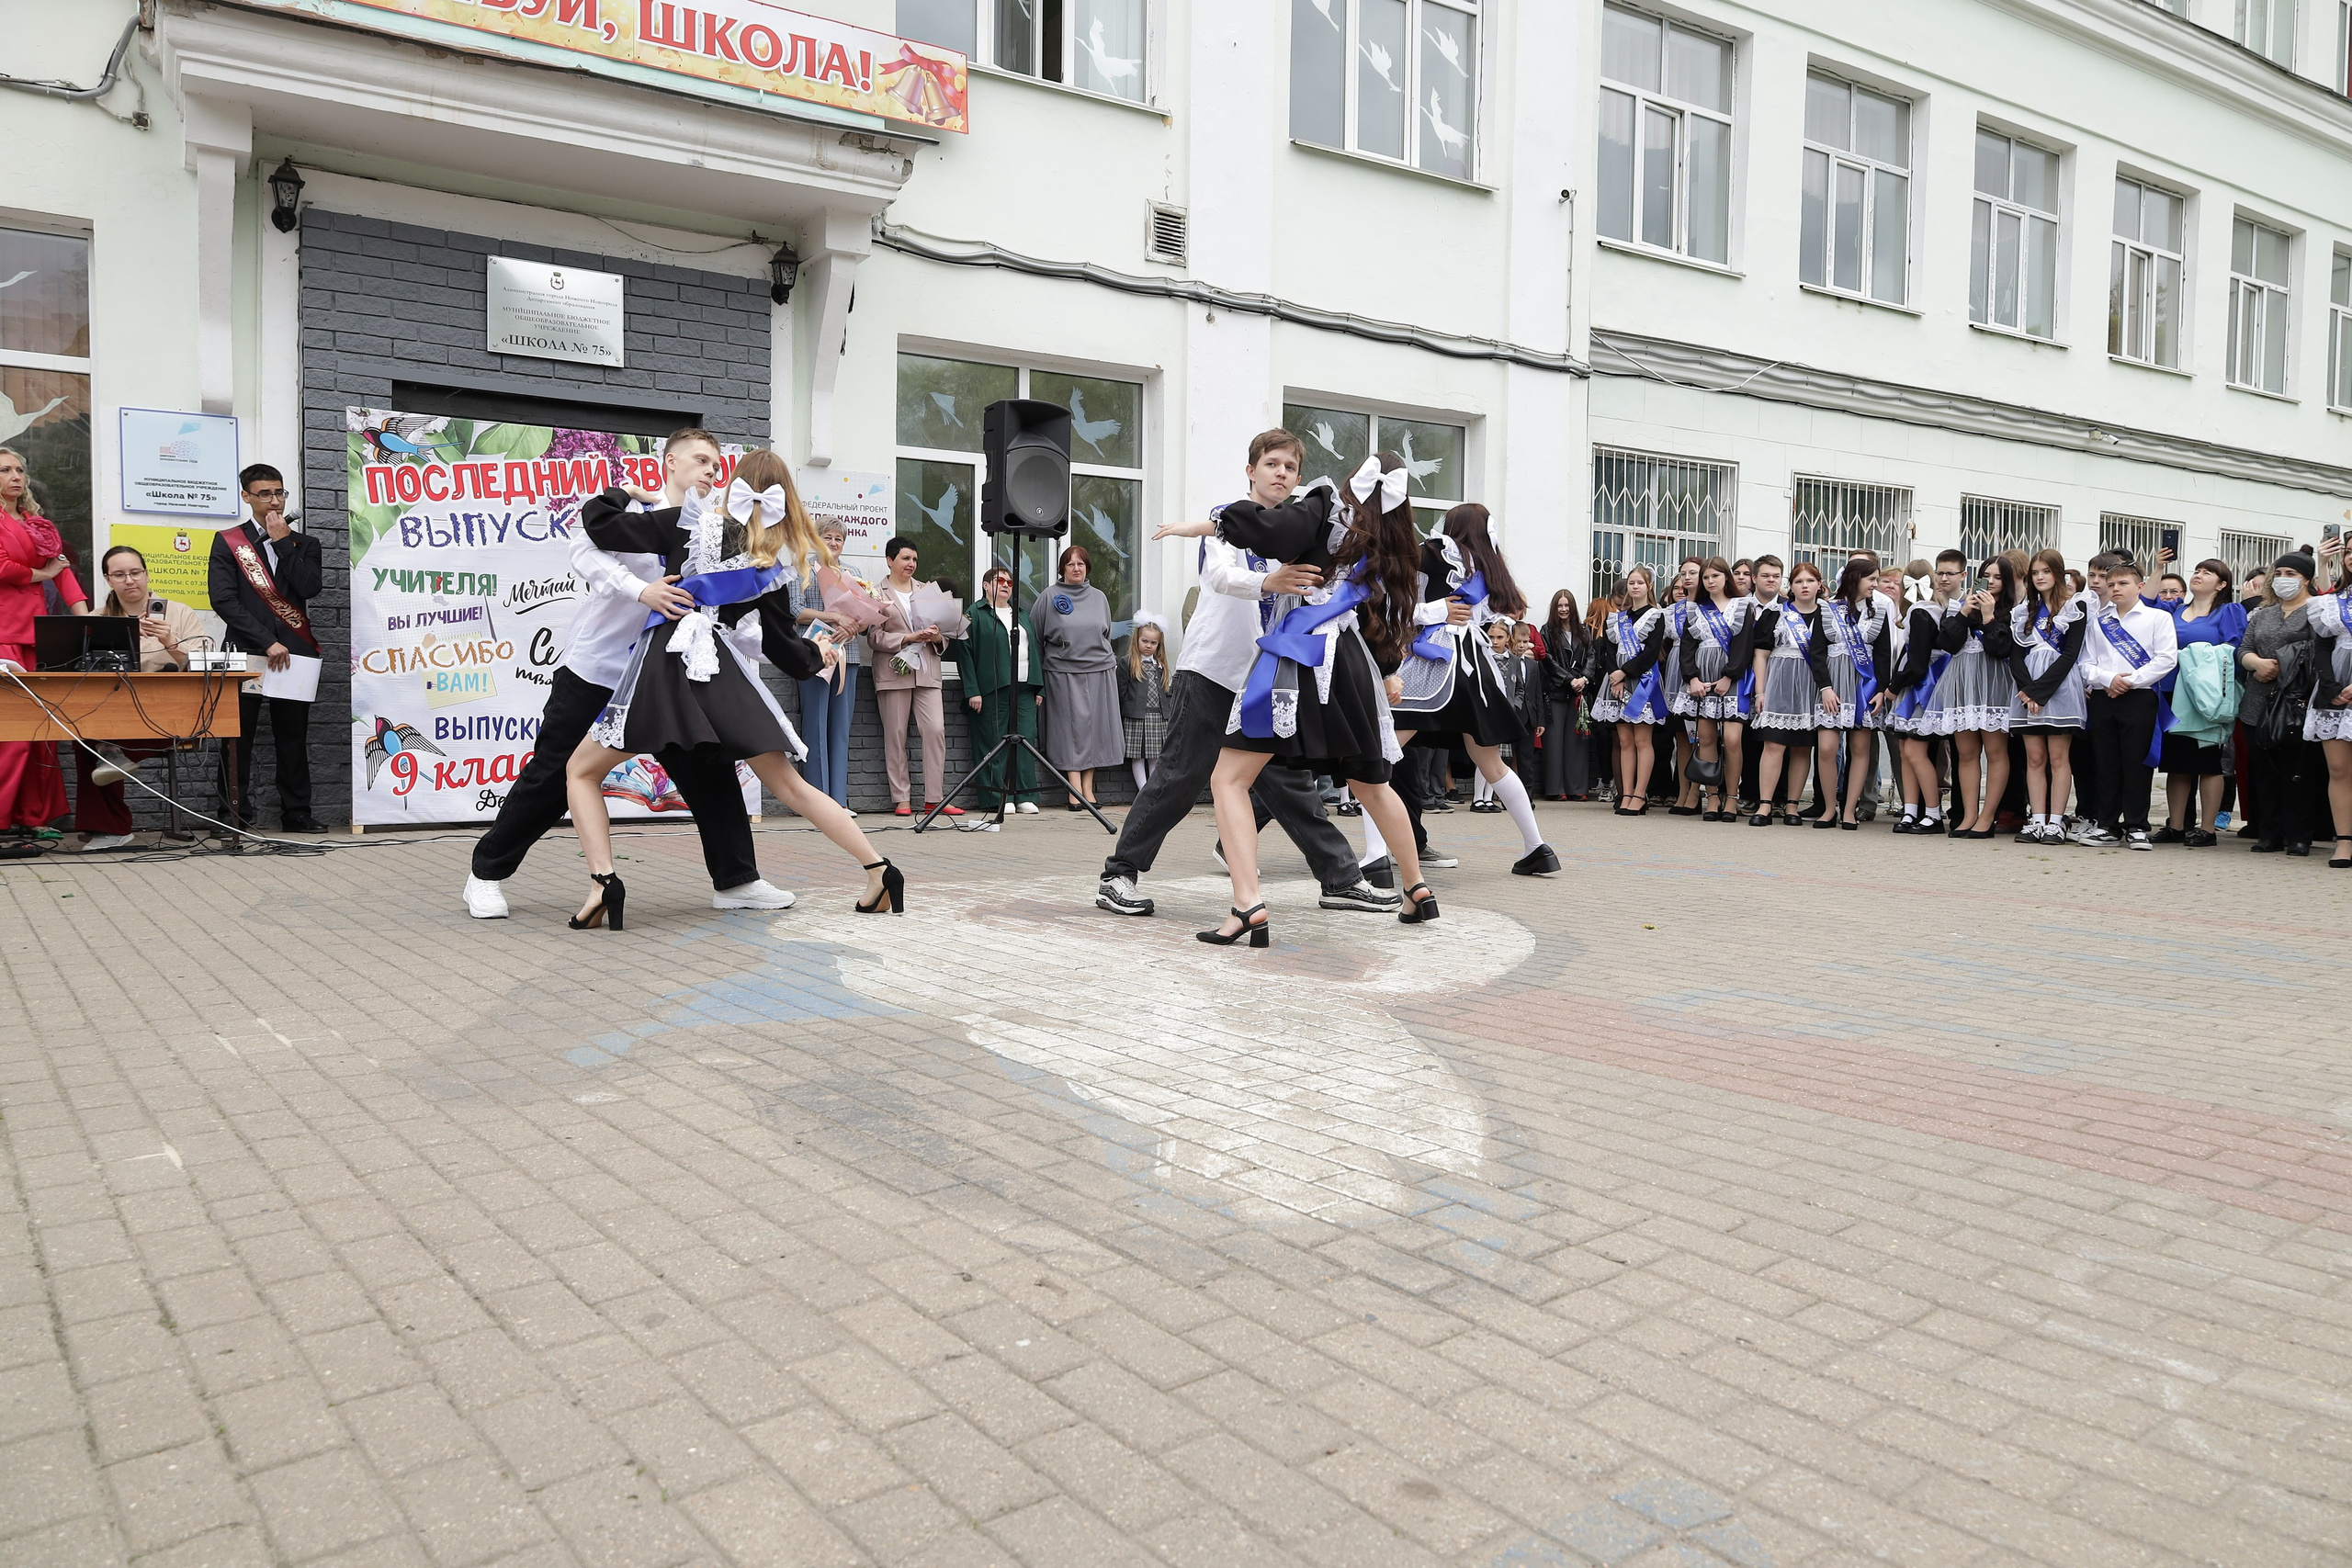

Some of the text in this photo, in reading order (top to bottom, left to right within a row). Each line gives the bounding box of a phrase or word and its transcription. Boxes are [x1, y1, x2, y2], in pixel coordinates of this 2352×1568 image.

[639, 0, 872, 92] ШКОЛА!
[503, 306, 611, 325] МУНИЦИПАЛЬНОЕ БЮДЖЕТНОЕ
[514, 315, 599, 330] ОБЩЕОБРАЗОВАТЕЛЬНОЕ
[534, 324, 581, 334] УЧРЕЖДЕНИЕ
[502, 334, 612, 356] «ШКОЛА № 75»
[365, 454, 611, 505] ПОСЛЕДНИЙ
[146, 491, 185, 499] «Школа
[802, 501, 858, 511] ФЕДЕРАЛЬНЫЙ
[838, 514, 888, 525] КАЖДОГО
[371, 568, 497, 596] УЧИТЕЛЯ!
[503, 572, 579, 607] Мечтай
[388, 606, 483, 630] ВЫ ЛУЧШИЕ!
[363, 640, 514, 674] СПАСИБО
[1853, 647, 1869, 666] 2025
[437, 672, 487, 693] ВАМ!
[390, 751, 418, 795] 9
